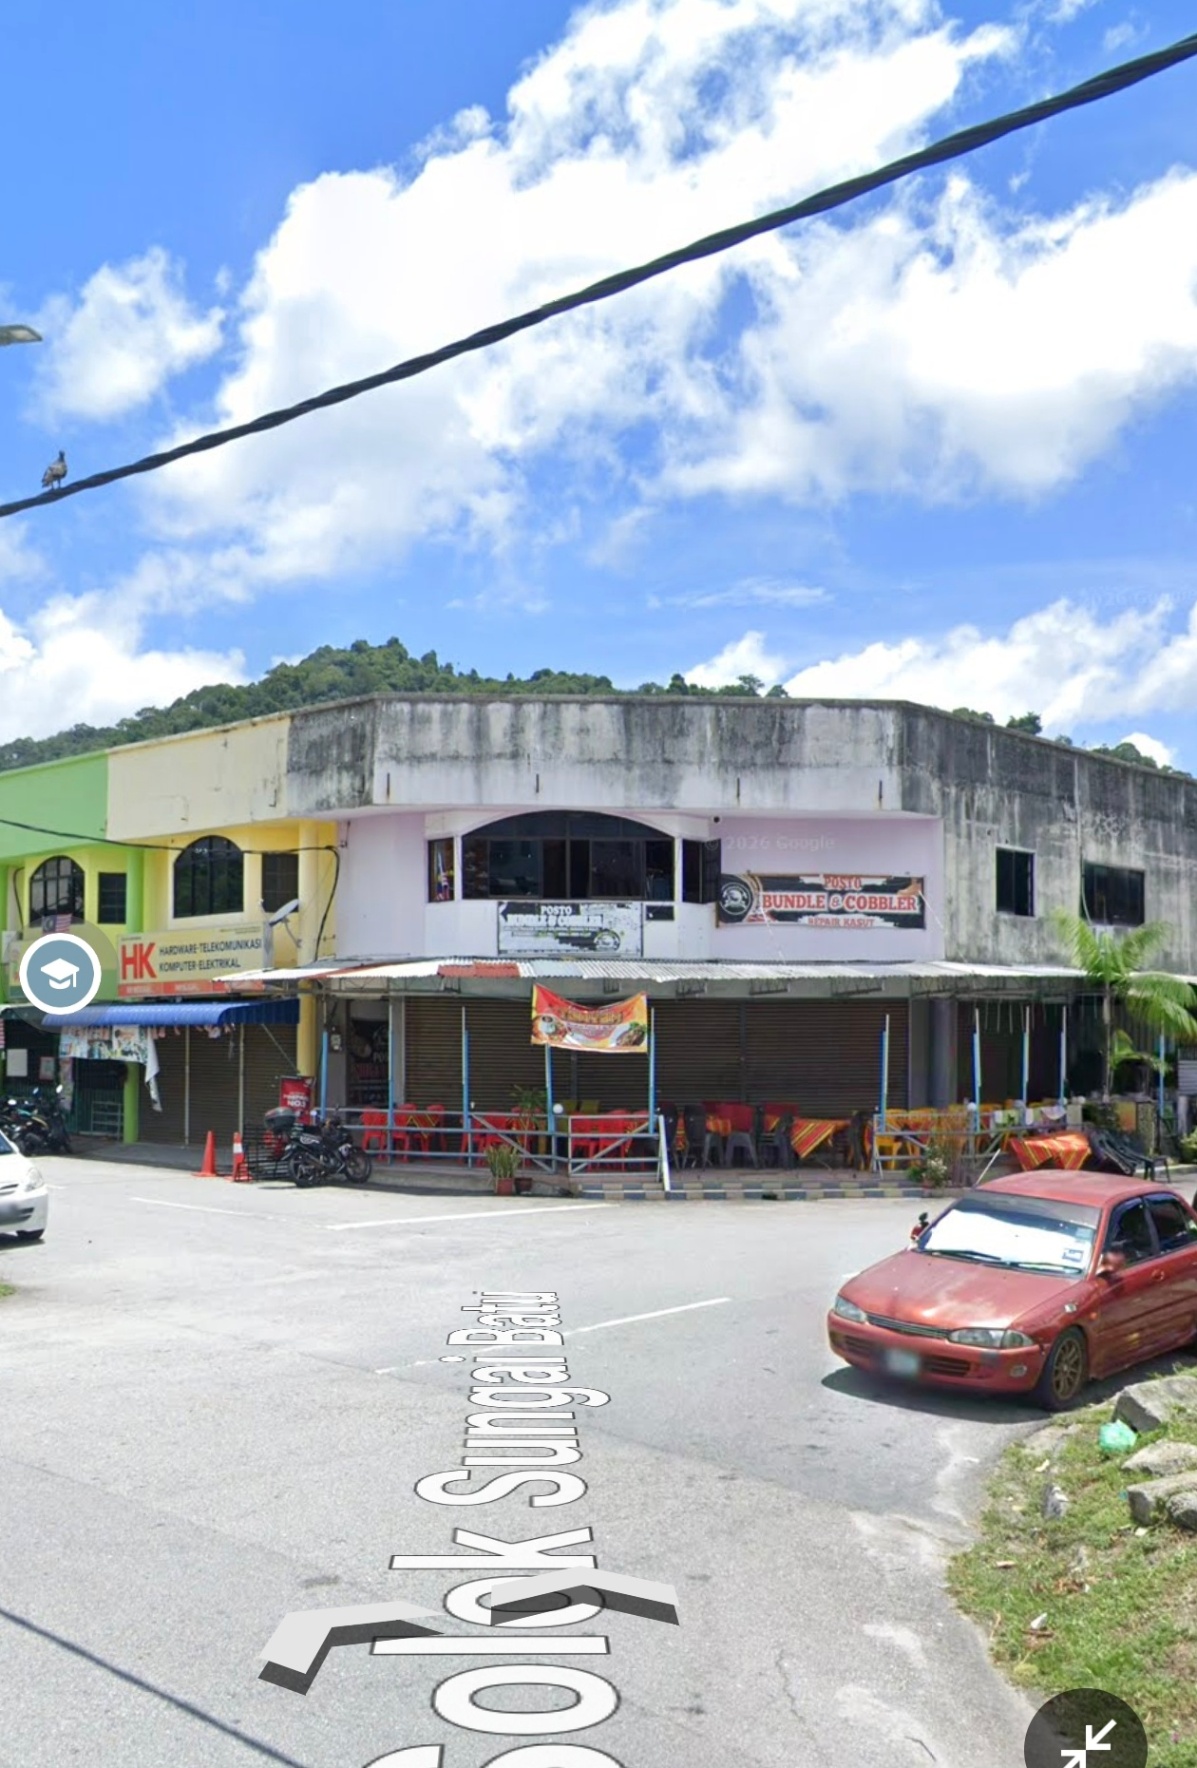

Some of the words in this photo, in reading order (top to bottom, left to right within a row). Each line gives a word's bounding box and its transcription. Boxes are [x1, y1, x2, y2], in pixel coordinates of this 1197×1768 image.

[824, 876, 863, 890] POSTO
[762, 894, 826, 909] BUNDLE
[830, 895, 841, 909] &
[844, 894, 918, 911] COBBLER
[540, 905, 572, 915] POSTO
[808, 917, 842, 928] REPAIR
[844, 917, 875, 928] KASUT
[121, 942, 157, 980] HK
